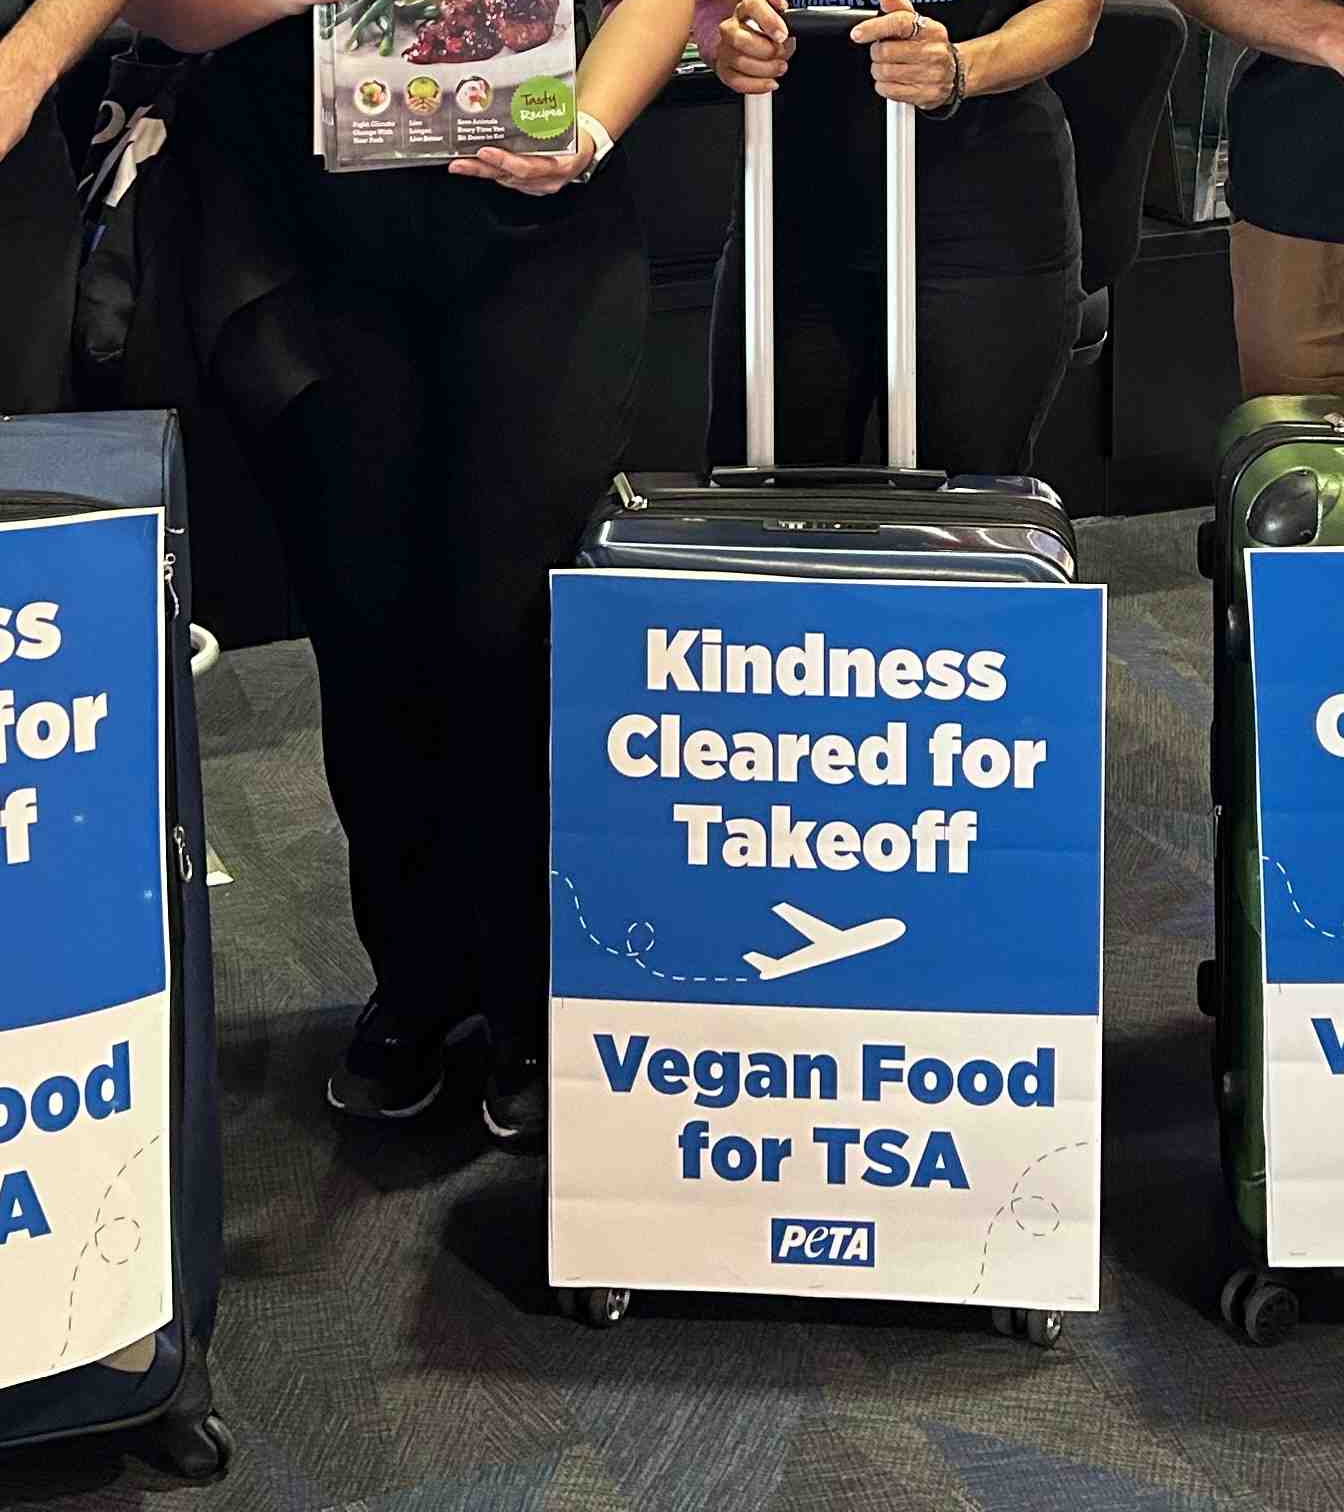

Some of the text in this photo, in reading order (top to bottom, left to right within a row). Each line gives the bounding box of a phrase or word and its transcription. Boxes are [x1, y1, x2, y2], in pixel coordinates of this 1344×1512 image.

[519, 105, 568, 122] Recipes!
[521, 94, 557, 109] Tasty
[647, 628, 1008, 701] Kindness
[607, 714, 1047, 789] Cleared for
[673, 804, 978, 874] Takeoff
[593, 1034, 1056, 1108] Vegan Food
[678, 1121, 970, 1189] for TSA
[778, 1225, 869, 1262] PeTA
